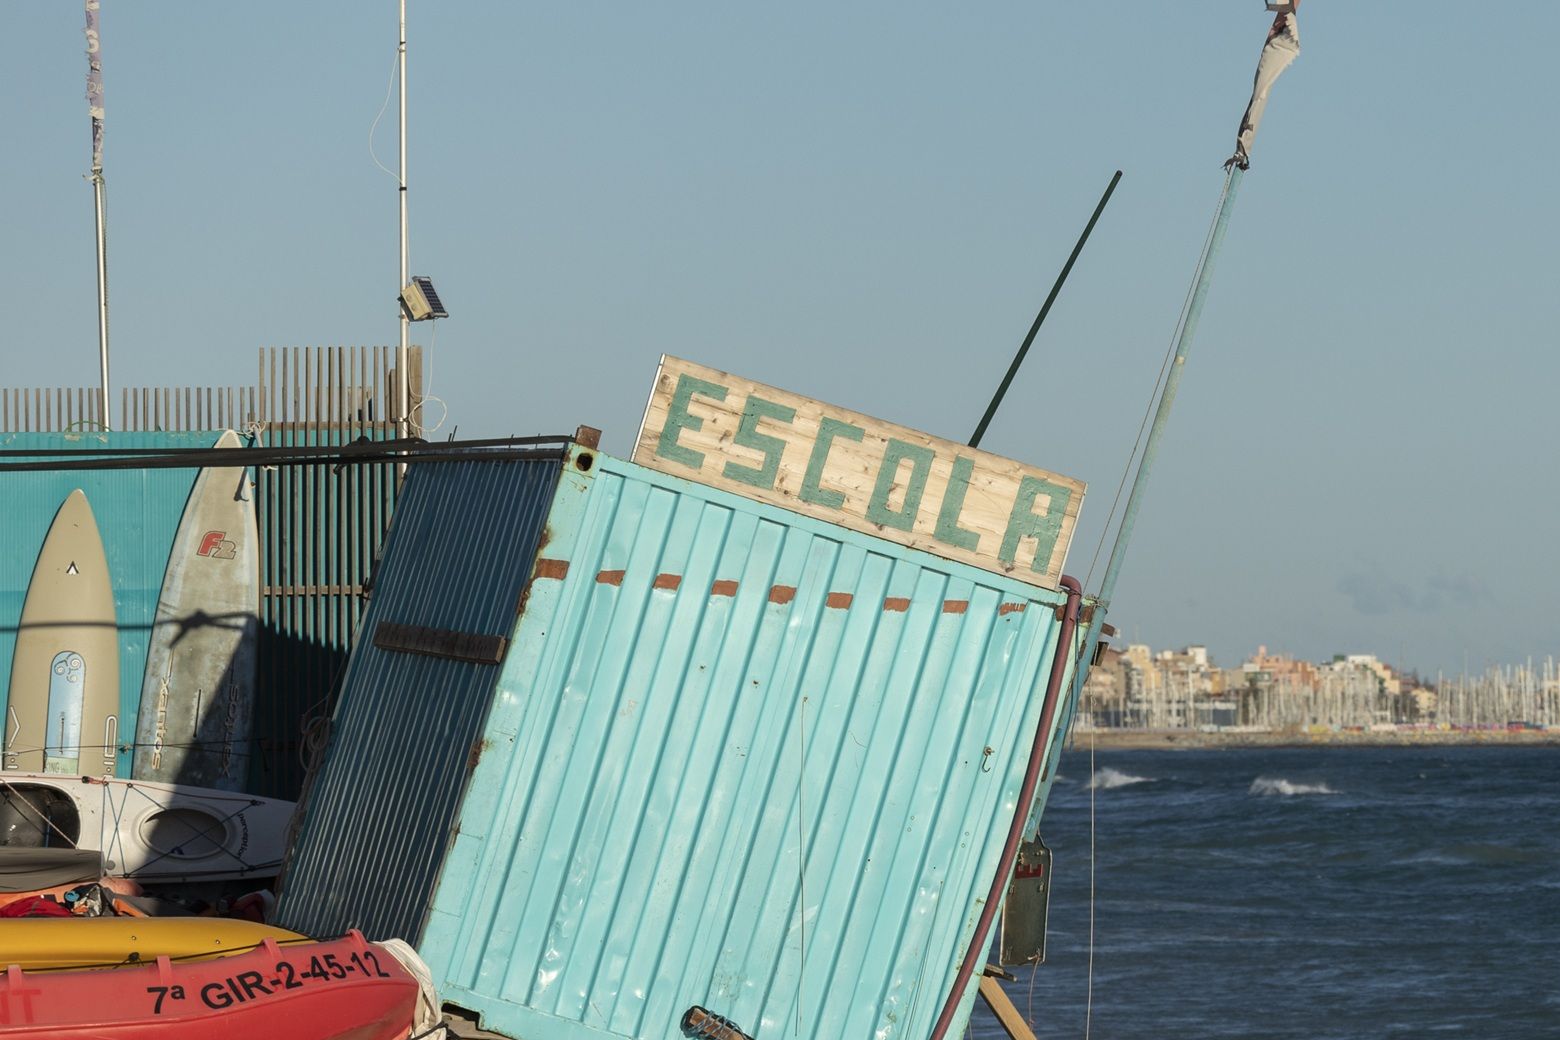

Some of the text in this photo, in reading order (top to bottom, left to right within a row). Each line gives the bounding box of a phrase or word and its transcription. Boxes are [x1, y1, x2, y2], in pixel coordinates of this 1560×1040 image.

[655, 373, 1072, 575] ESCOLA
[196, 530, 237, 560] F2
[200, 950, 390, 1010] GIR-2-45-12
